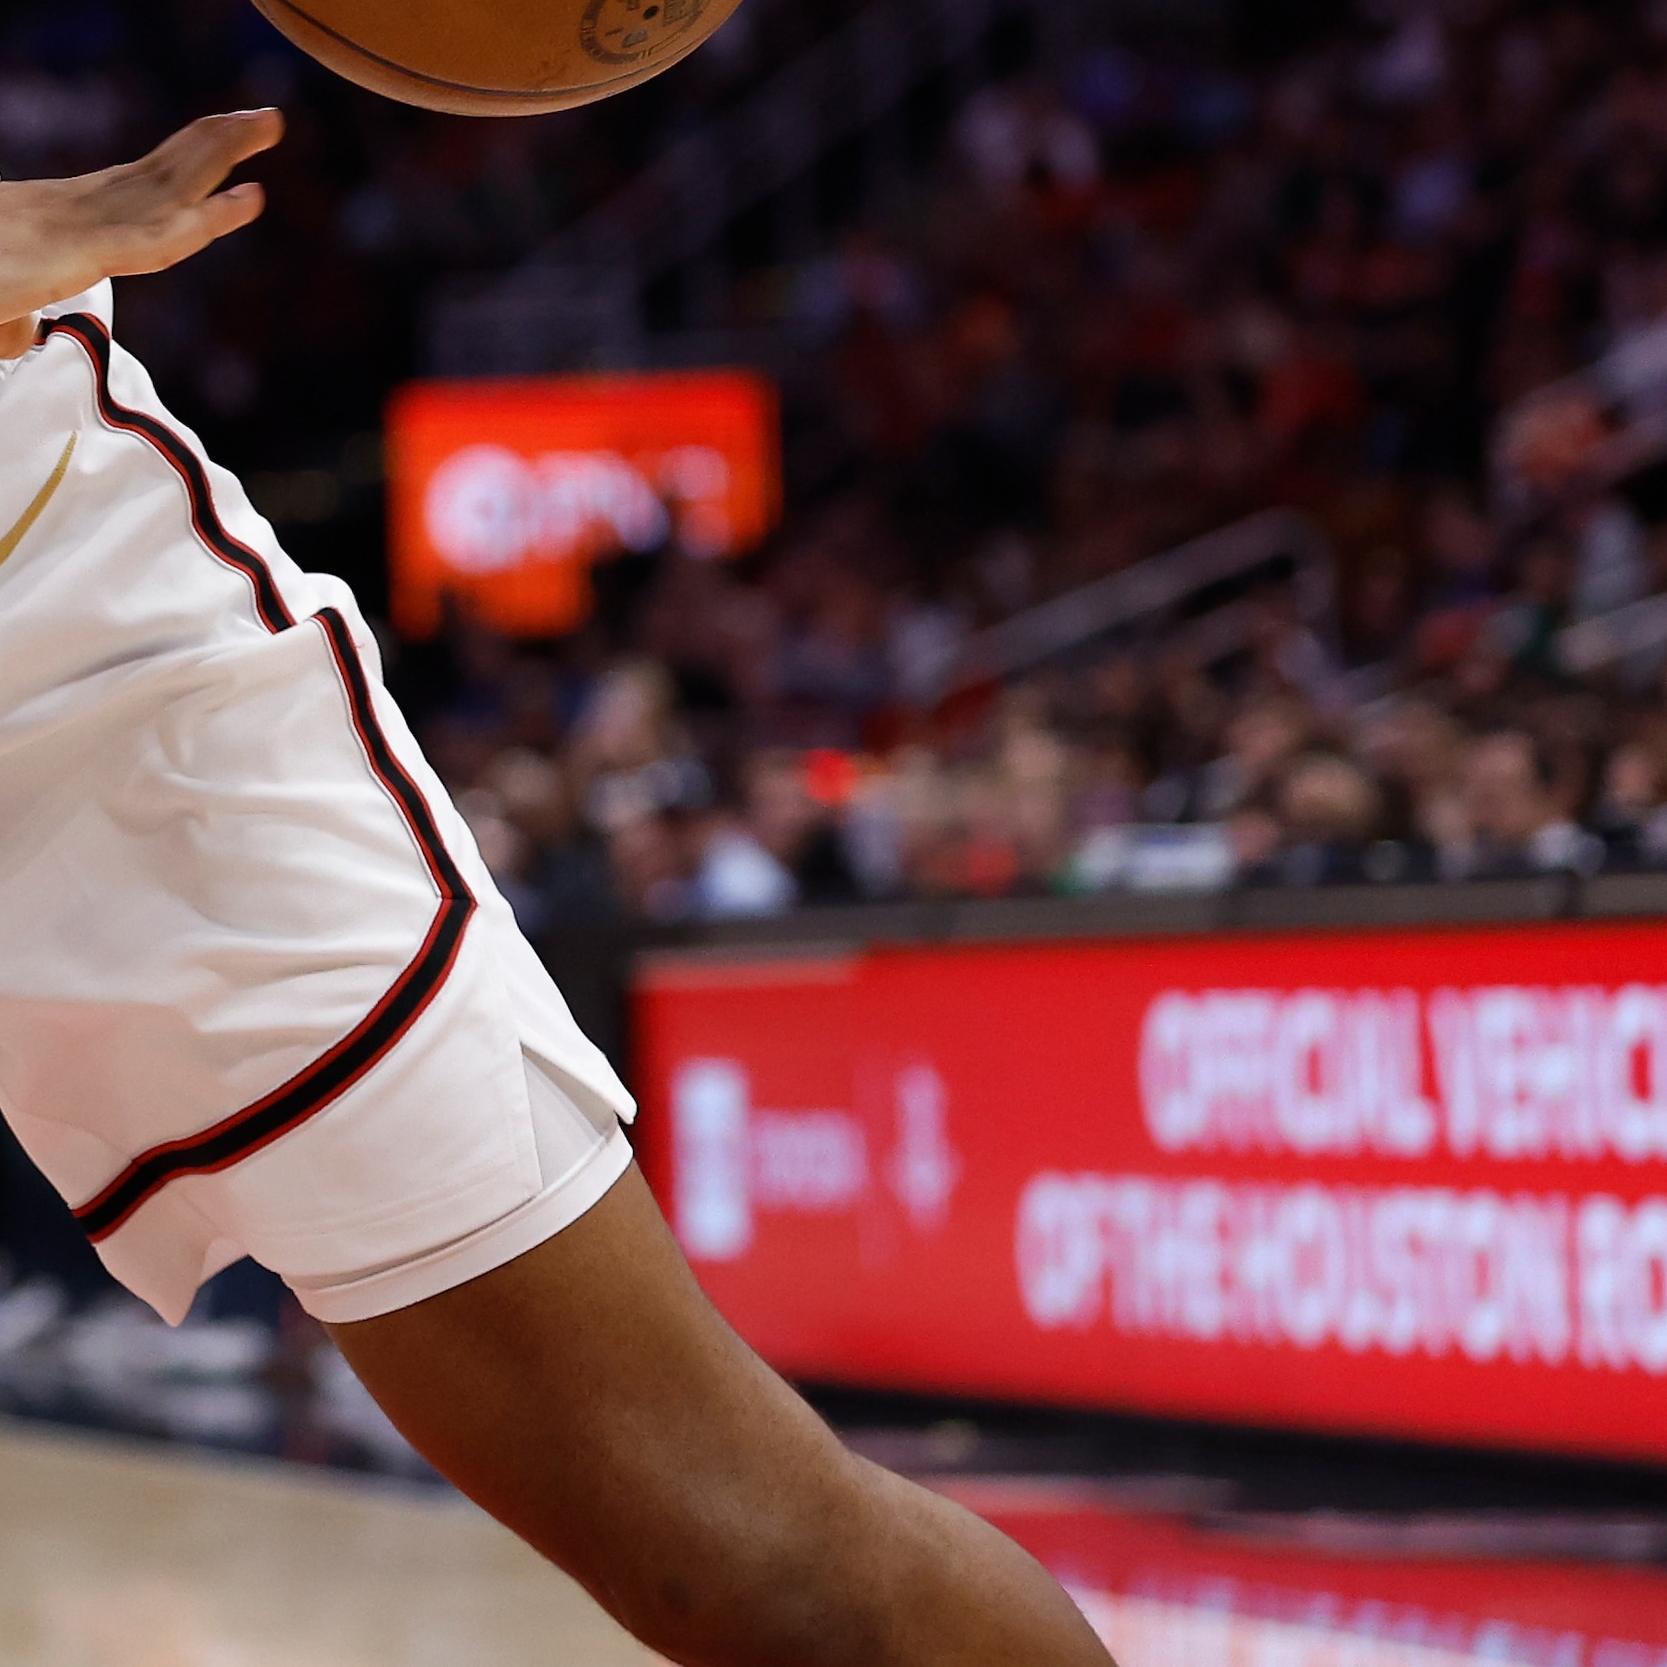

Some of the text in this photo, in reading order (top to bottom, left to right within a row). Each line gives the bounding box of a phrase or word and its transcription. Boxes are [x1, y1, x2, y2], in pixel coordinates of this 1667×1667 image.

[1138, 989, 1436, 1154] OFFICIAL
[1015, 1168, 1104, 1333] OF
[1104, 1173, 1226, 1339] THE
[1229, 1180, 1568, 1363] HOUSTON
